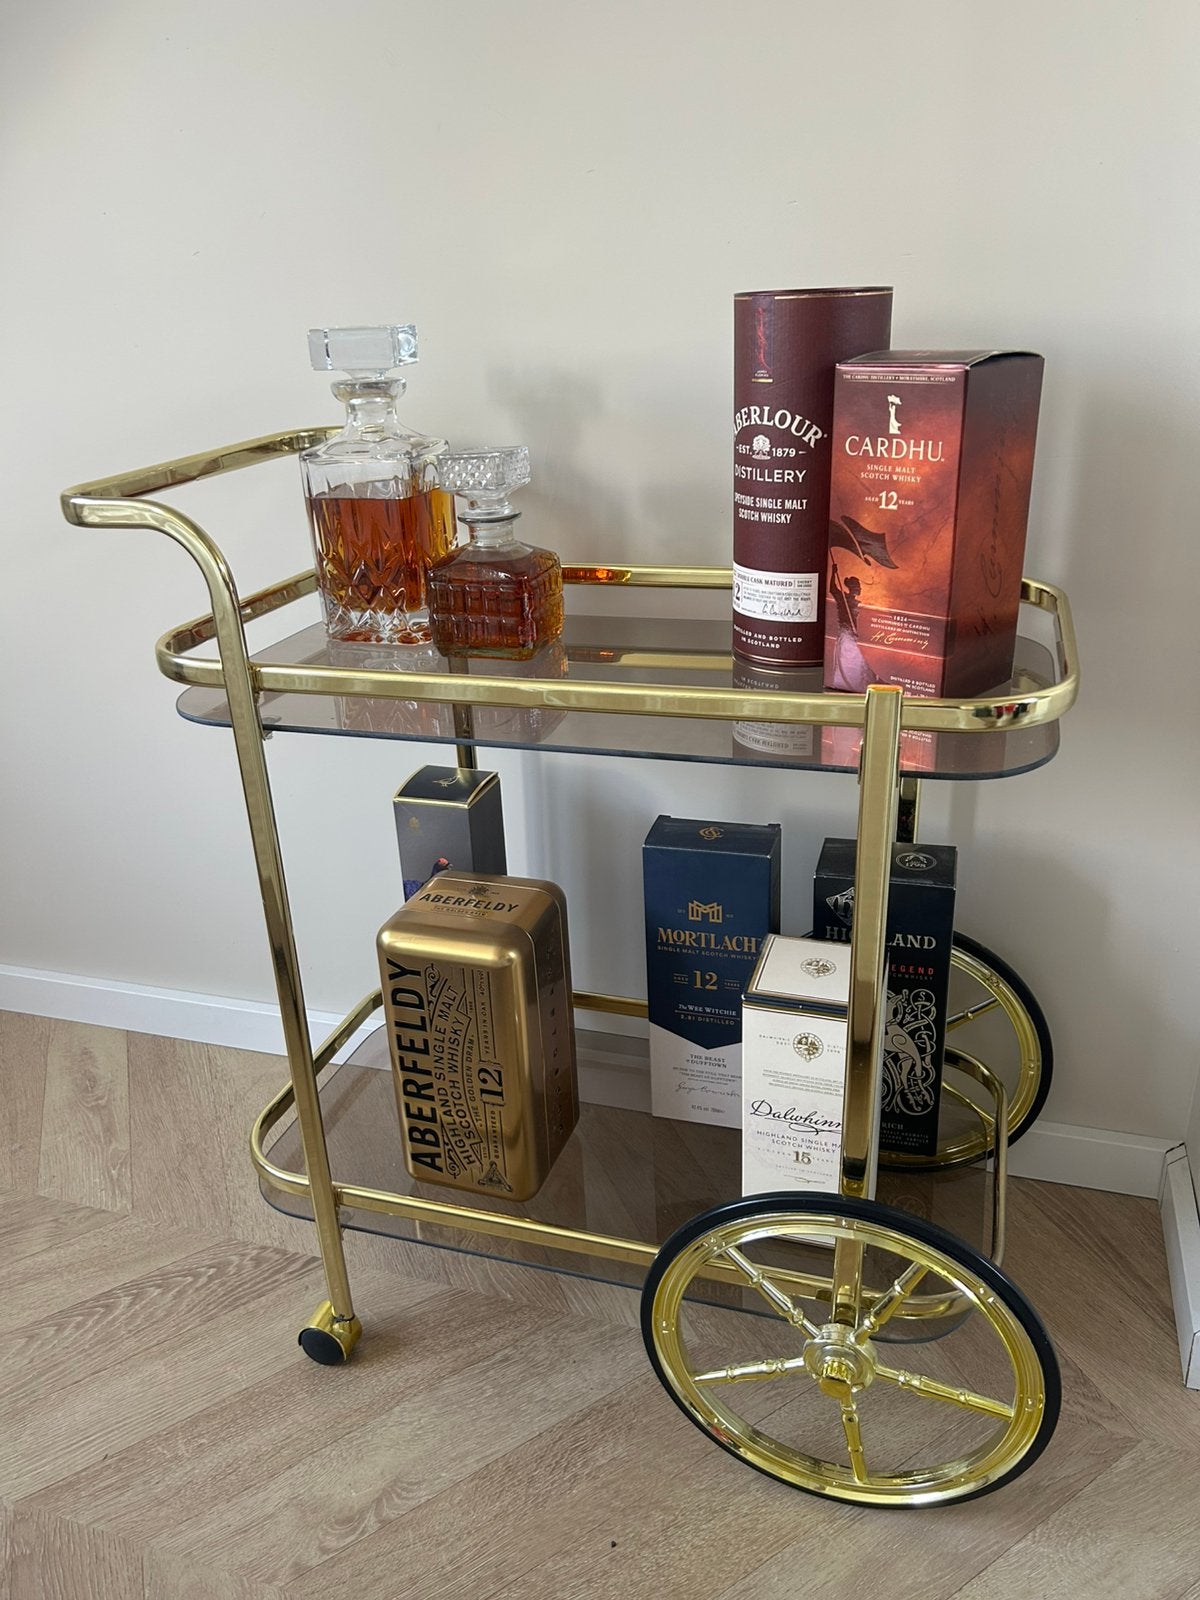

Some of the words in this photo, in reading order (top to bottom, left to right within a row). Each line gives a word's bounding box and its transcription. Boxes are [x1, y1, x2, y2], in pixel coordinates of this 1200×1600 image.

[771, 447, 796, 458] 1879
[845, 435, 943, 462] CARDHU
[860, 471, 890, 481] SCOTCH
[892, 474, 922, 483] WHISKY
[866, 463, 892, 473] SINGLE
[894, 465, 916, 474] MALT
[755, 497, 783, 510] SINGLE
[784, 499, 808, 510] MALT
[878, 490, 899, 511] 12
[738, 507, 760, 521] SCOTCH
[760, 512, 792, 524] WHISKY
[764, 579, 793, 588] MATURED
[747, 638, 781, 649] SCOTLAND
[768, 635, 803, 643] BOTTLED
[419, 893, 520, 913] ABERFELDY
[657, 927, 757, 954] MORTLACH
[825, 925, 937, 950] HIAND
[701, 950, 728, 958] SCOTCH
[891, 964, 934, 975] EGEND
[692, 969, 718, 991] 12
[437, 984, 459, 1022] MALT
[704, 1006, 737, 1016] WITCHIE
[697, 1017, 735, 1026] DISTILLED
[433, 1025, 447, 1081] SINGLE
[446, 1016, 465, 1074] WHISKY
[465, 1038, 475, 1063] DRAM
[387, 957, 443, 1174] ABERFELDY
[466, 1065, 477, 1102] GOLDEN
[478, 1067, 505, 1102] 12
[448, 1079, 477, 1139] SCOTCH
[471, 1105, 482, 1123] THE
[437, 1086, 477, 1166] HIGHLAND
[756, 1130, 798, 1141] HIGHLAND
[801, 1137, 828, 1146] SINGLE
[771, 1138, 803, 1148] SCOTCH
[805, 1145, 836, 1154] WHISKY
[792, 1150, 813, 1166] 15
